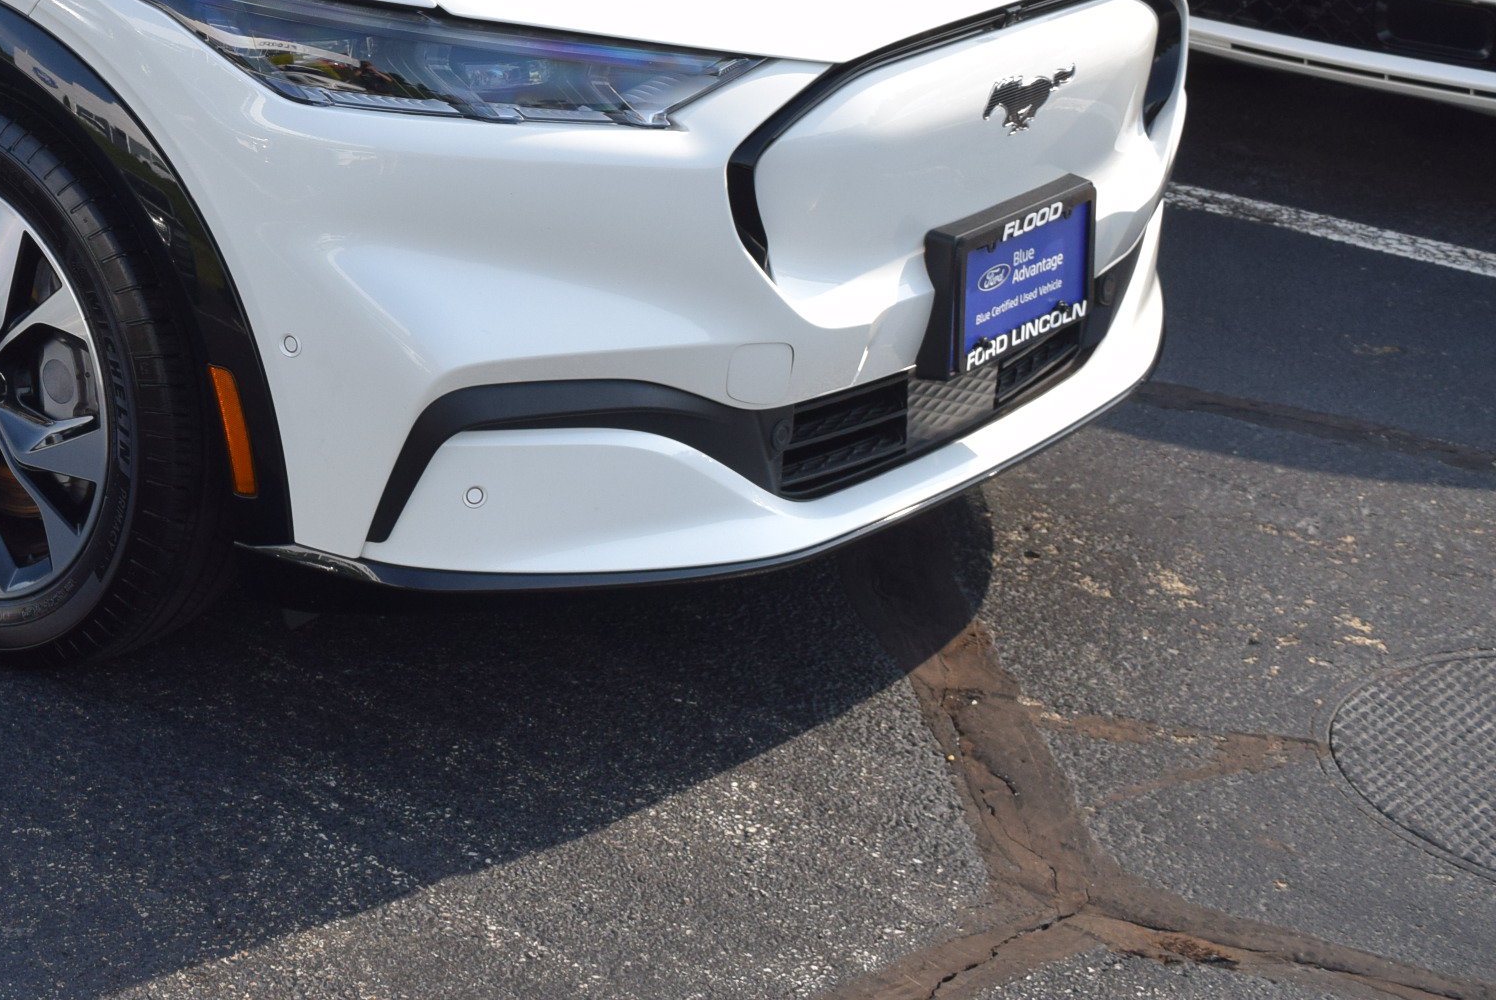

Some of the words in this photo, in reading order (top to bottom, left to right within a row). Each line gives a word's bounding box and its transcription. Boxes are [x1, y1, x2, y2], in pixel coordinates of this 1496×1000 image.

[1002, 201, 1063, 241] FLOOD
[1012, 253, 1064, 284] Advantage
[1013, 248, 1035, 266] Blue
[982, 266, 1007, 289] Ford
[976, 311, 991, 325] Blue
[991, 295, 1019, 317] Certified
[1019, 288, 1038, 304] Used
[1039, 279, 1063, 296] Vehicle
[966, 334, 1009, 371] FORD
[1012, 299, 1088, 347] LINCOLN
[85, 290, 132, 467] MICHELIN
